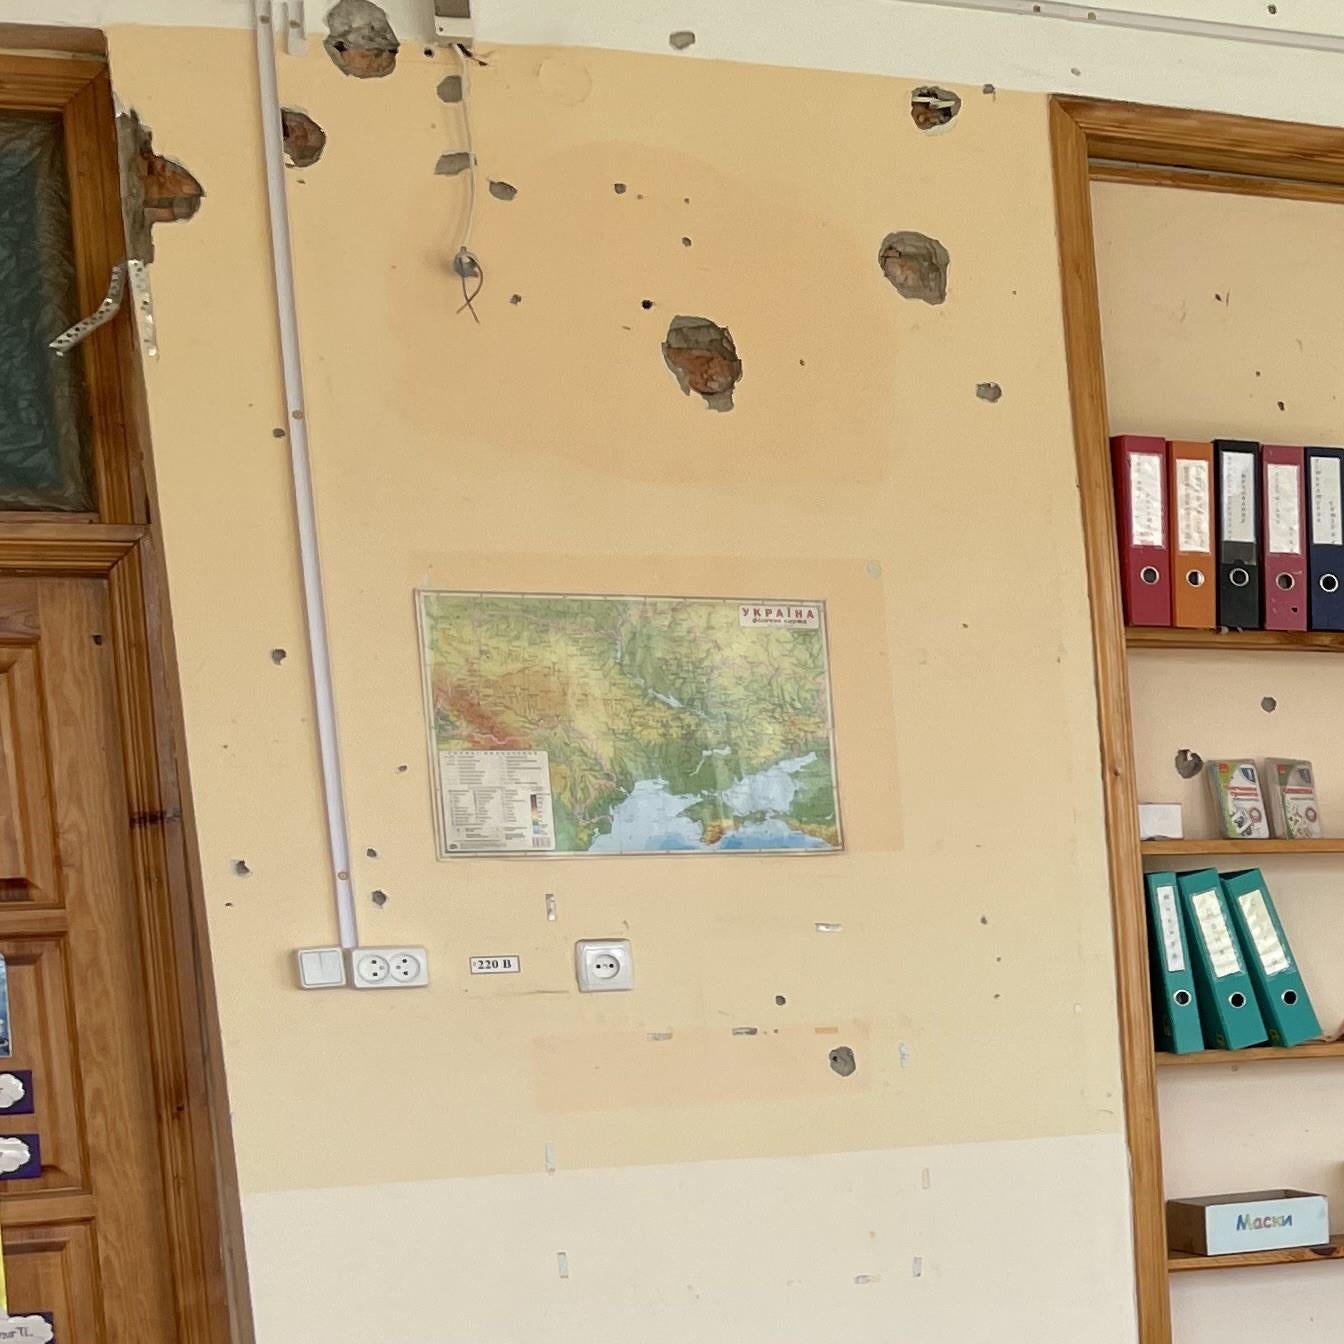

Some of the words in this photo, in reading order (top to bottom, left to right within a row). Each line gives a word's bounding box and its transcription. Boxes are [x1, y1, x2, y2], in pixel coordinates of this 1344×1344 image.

[742, 607, 815, 619] УКРАЇНА
[477, 959, 498, 969] 220
[1236, 1214, 1293, 1231] Маски
